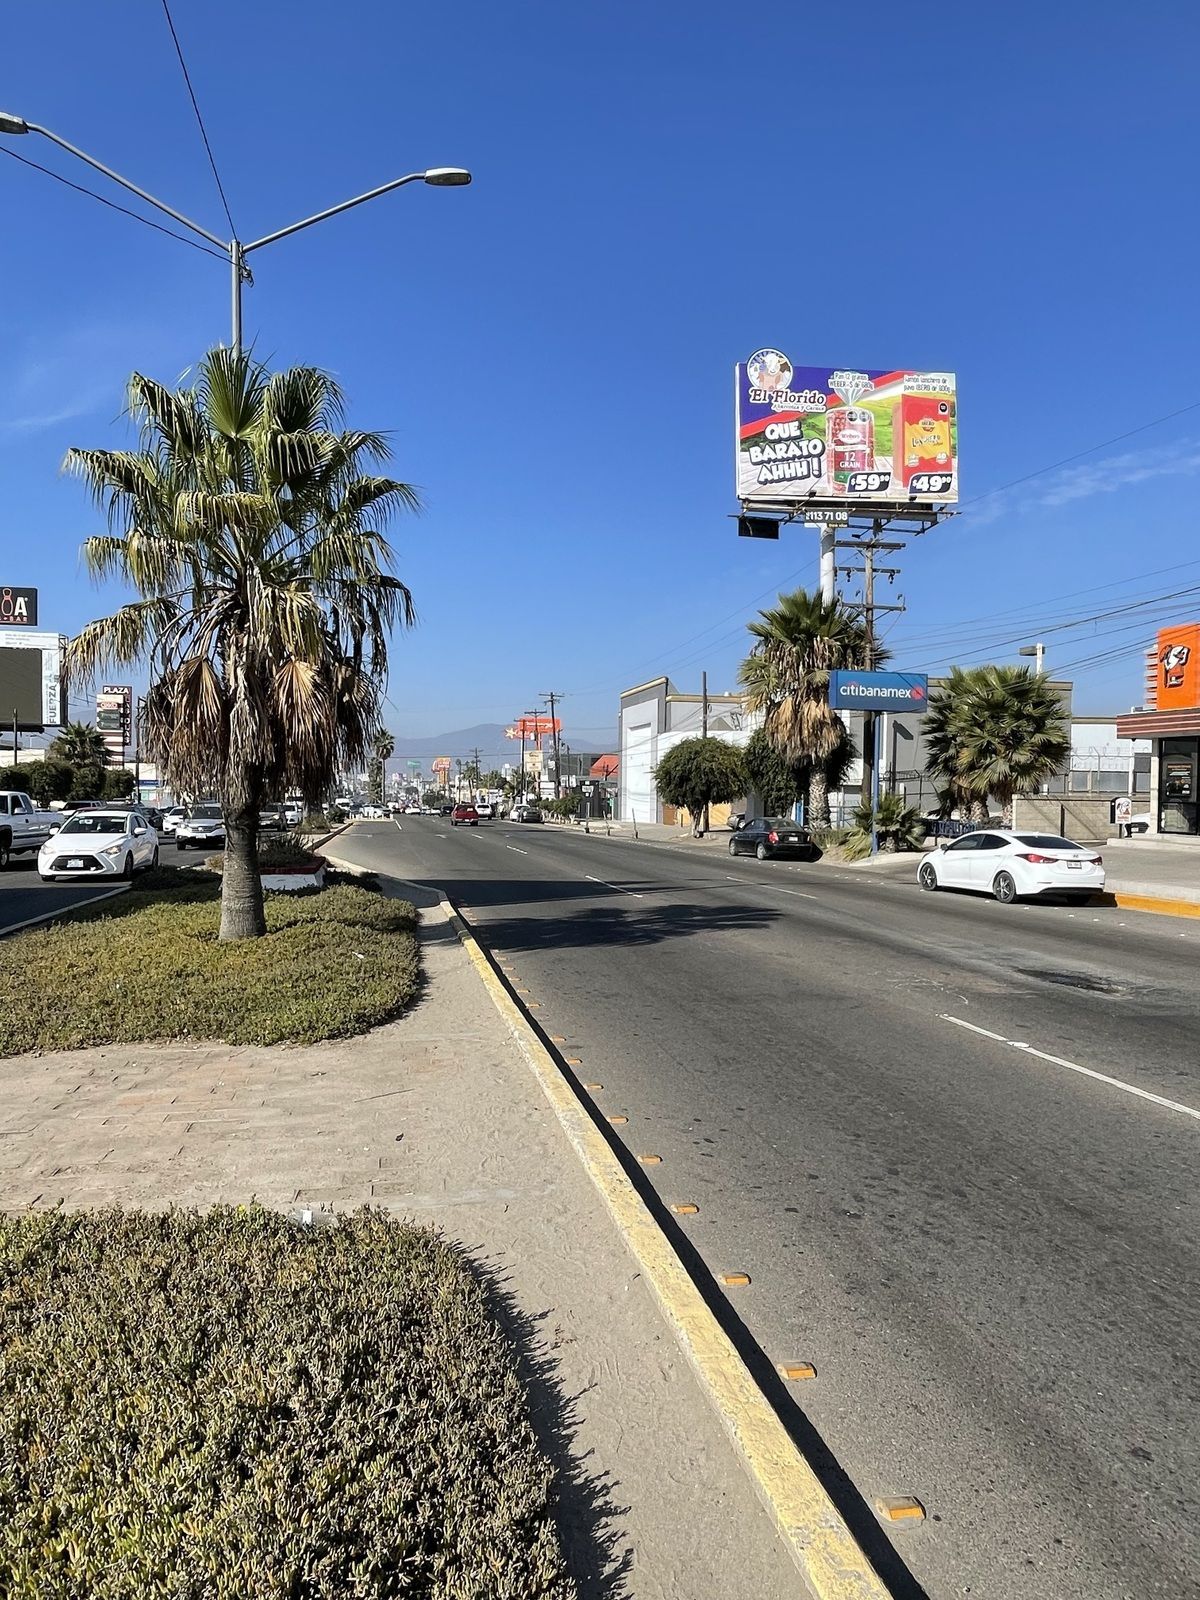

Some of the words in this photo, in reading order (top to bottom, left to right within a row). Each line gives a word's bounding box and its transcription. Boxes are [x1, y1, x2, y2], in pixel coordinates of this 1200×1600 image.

[751, 388, 769, 402] El
[772, 389, 825, 404] Florido
[765, 420, 802, 440] QUE
[749, 438, 823, 464] BARATO
[844, 452, 856, 462] 12
[824, 511, 834, 521] 71
[835, 511, 848, 521] 08
[840, 684, 912, 698] citibanamex
